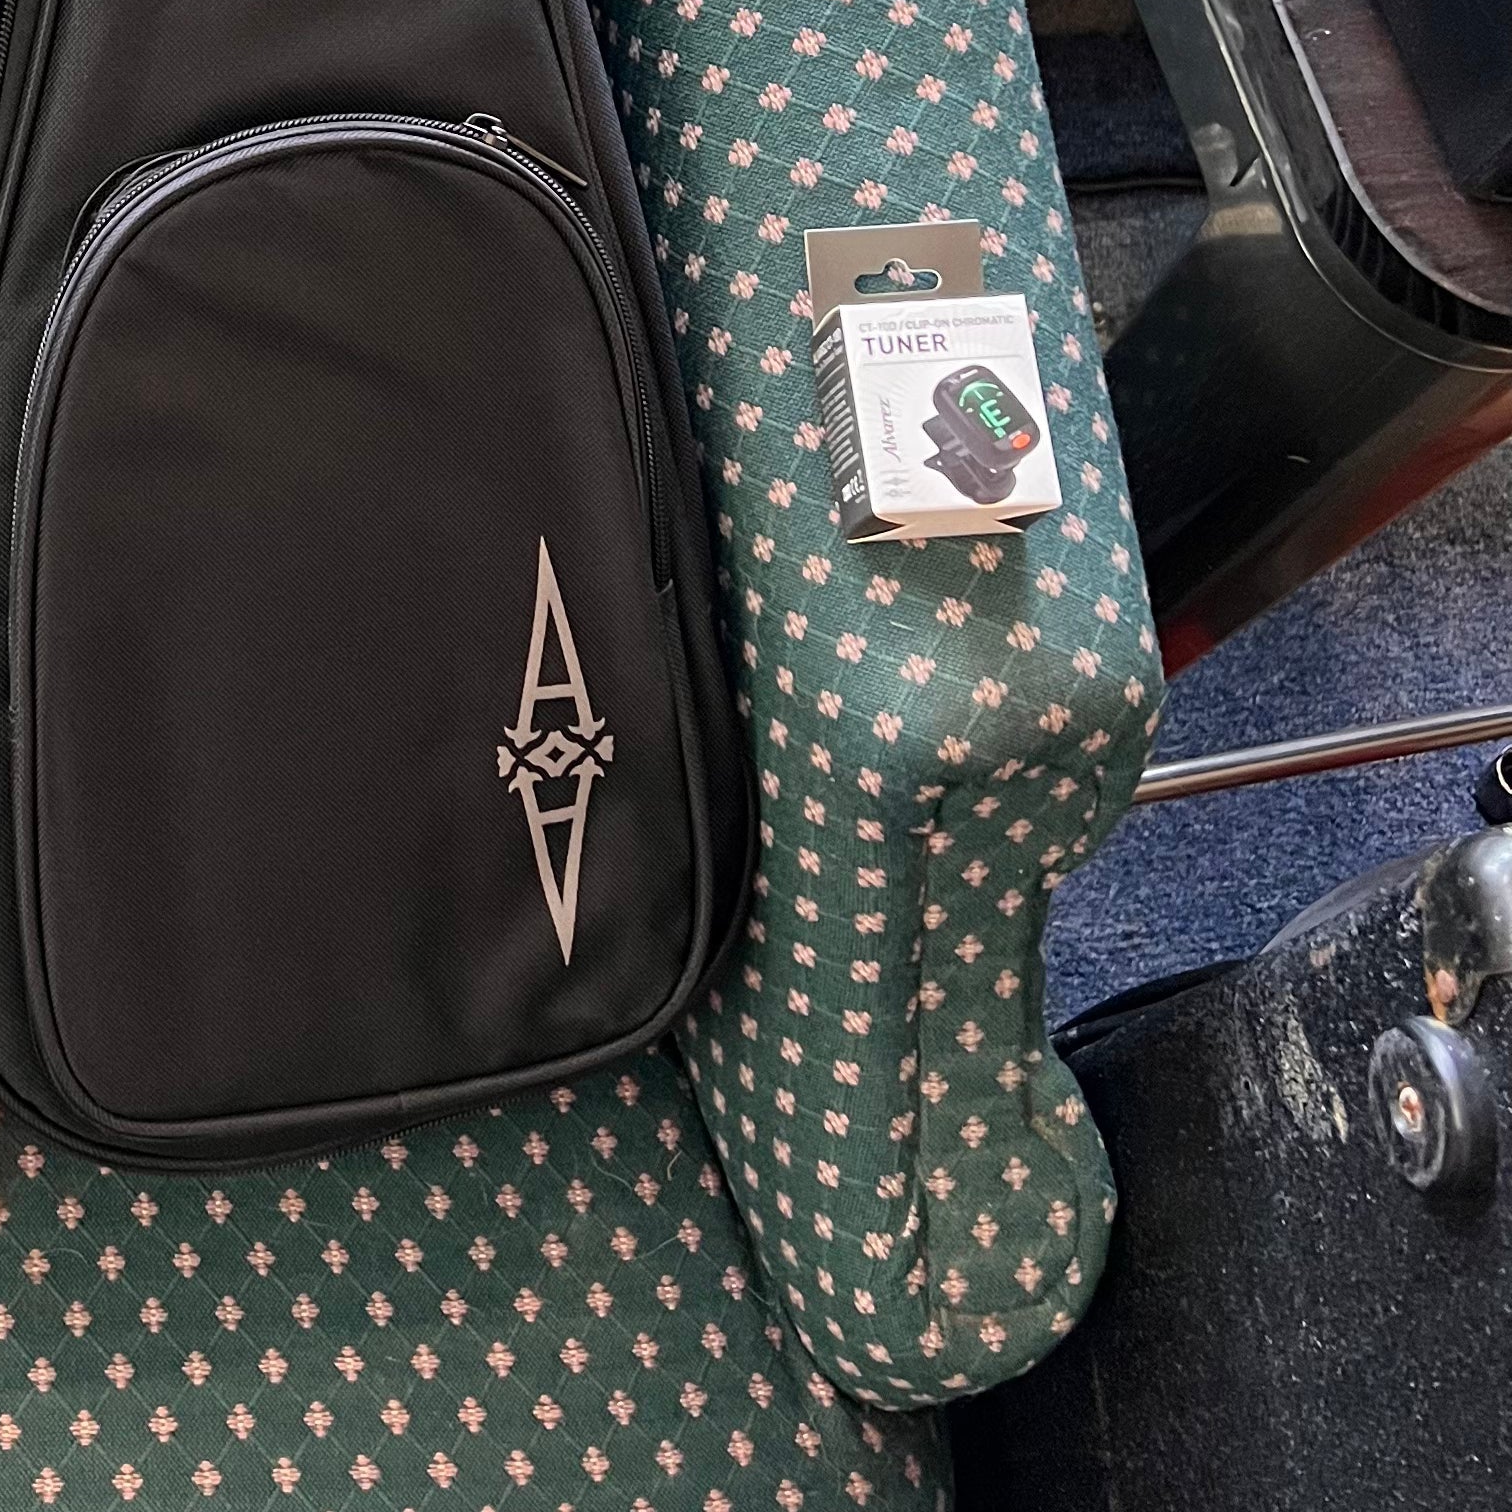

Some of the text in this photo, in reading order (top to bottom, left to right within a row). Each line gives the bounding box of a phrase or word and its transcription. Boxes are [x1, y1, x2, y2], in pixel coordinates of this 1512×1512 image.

[905, 318, 950, 330] CLIP-ON
[952, 314, 1015, 328] CHROMATIC
[861, 333, 949, 356] TUNER
[879, 397, 902, 464] Alvarez
